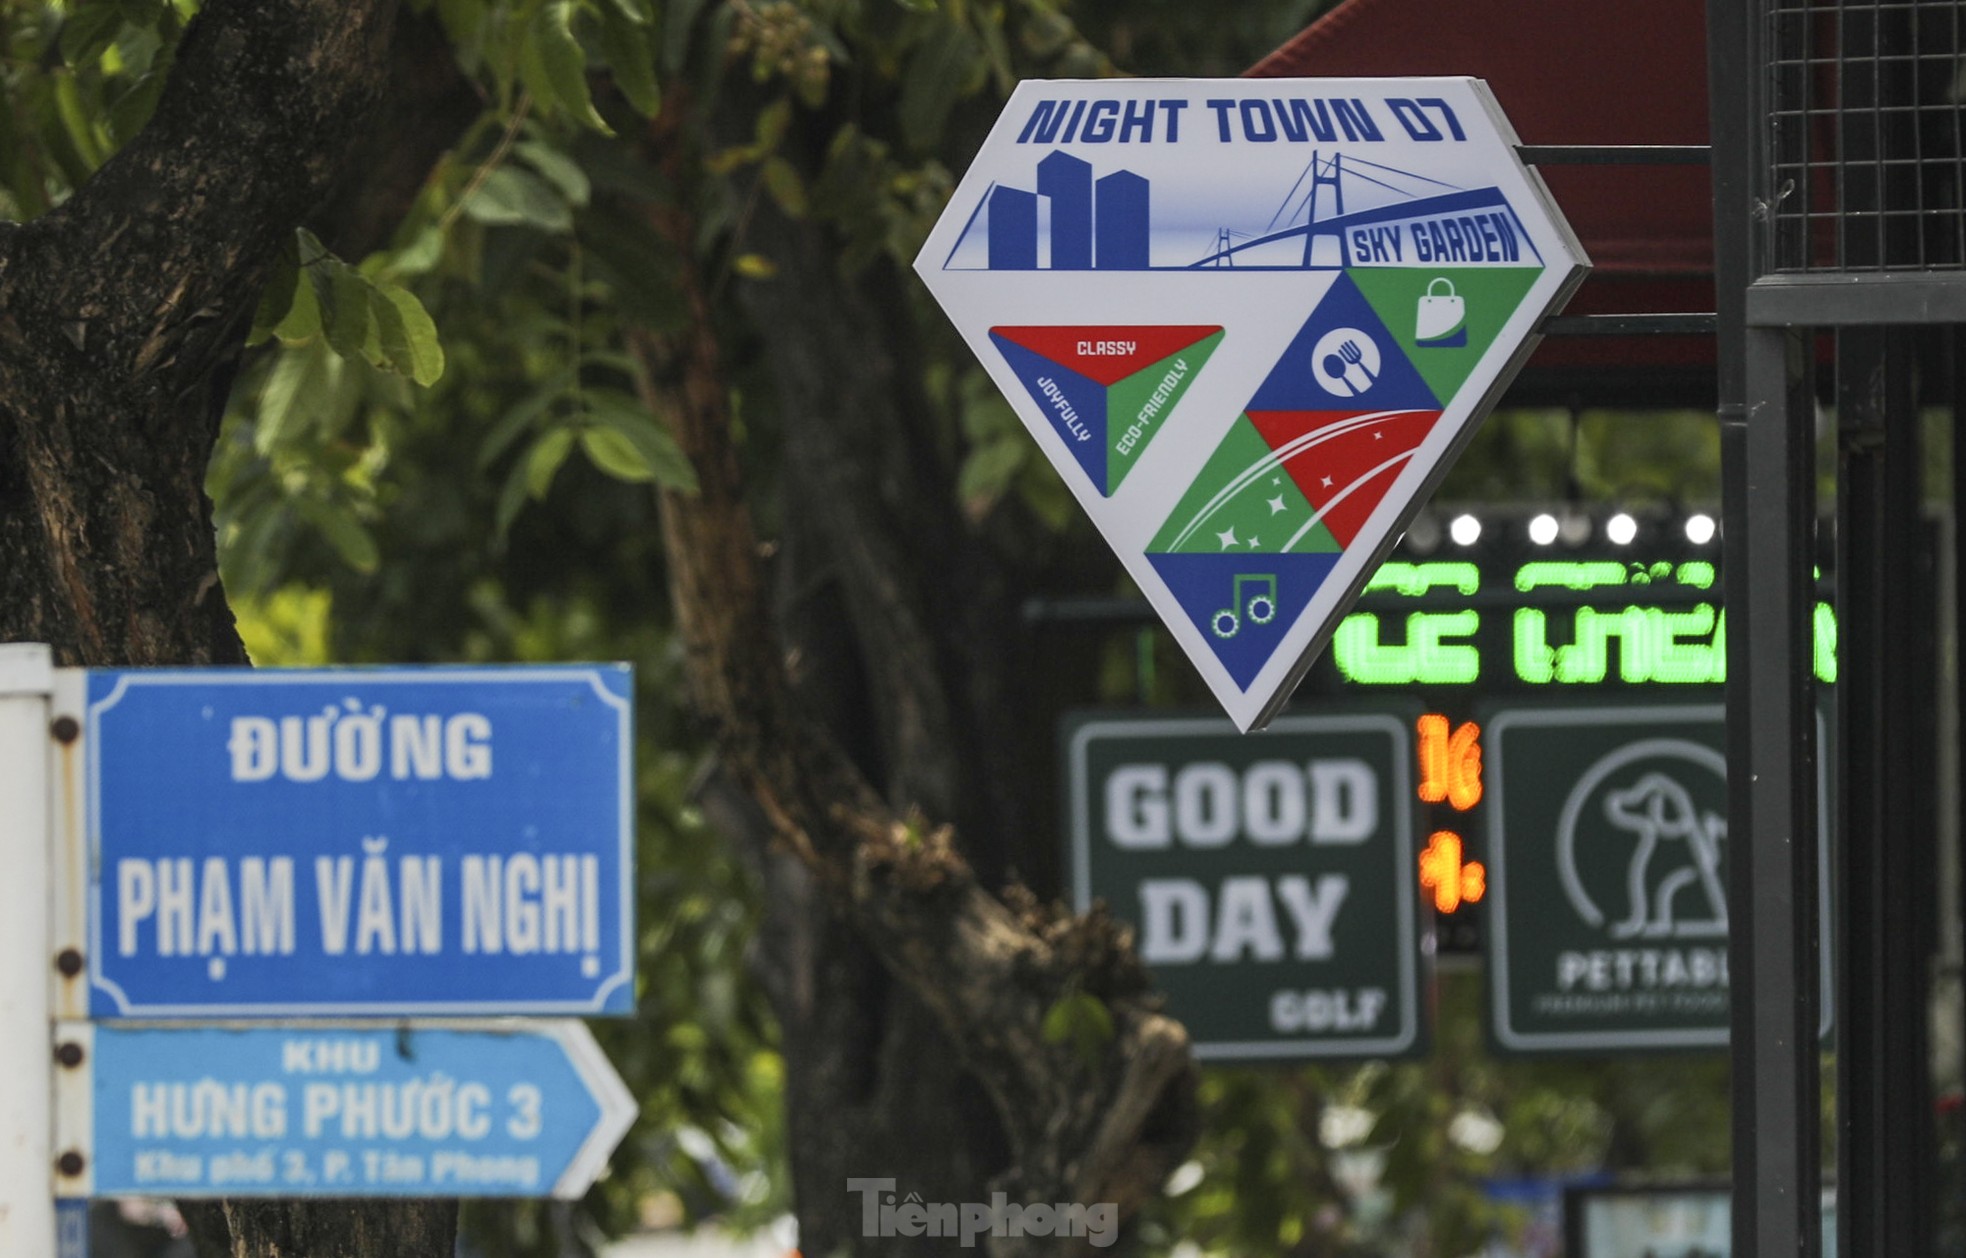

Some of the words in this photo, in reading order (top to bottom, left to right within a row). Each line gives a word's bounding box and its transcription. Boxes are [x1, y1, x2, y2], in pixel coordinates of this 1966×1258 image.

[1016, 99, 1189, 143] NIGHT
[1206, 98, 1386, 143] TOWN
[1384, 97, 1468, 142] 07
[1353, 225, 1403, 263] SKY
[1410, 211, 1520, 263] GARDEN
[1077, 340, 1137, 356] CLASSY
[1037, 376, 1092, 442] JOYFULLY
[1115, 358, 1188, 456] ECO-FRIENDLY
[226, 696, 494, 783] ĐƯỜNG
[1105, 757, 1380, 848] GOOD
[117, 856, 296, 982] PHẠM
[314, 834, 443, 955] VĂN
[460, 852, 600, 979] NGHỊ
[1138, 873, 1349, 965] DAY
[1269, 987, 1387, 1034] GOLF
[282, 1040, 381, 1074] KHU
[131, 1076, 288, 1140] HƯNG
[303, 1070, 492, 1141] PHƯỚC
[507, 1082, 543, 1141] 3
[134, 1148, 203, 1183] Khu
[210, 1143, 277, 1187] phố
[322, 1148, 354, 1184] P.
[362, 1147, 426, 1183] Tân
[431, 1147, 540, 1189] Phong
